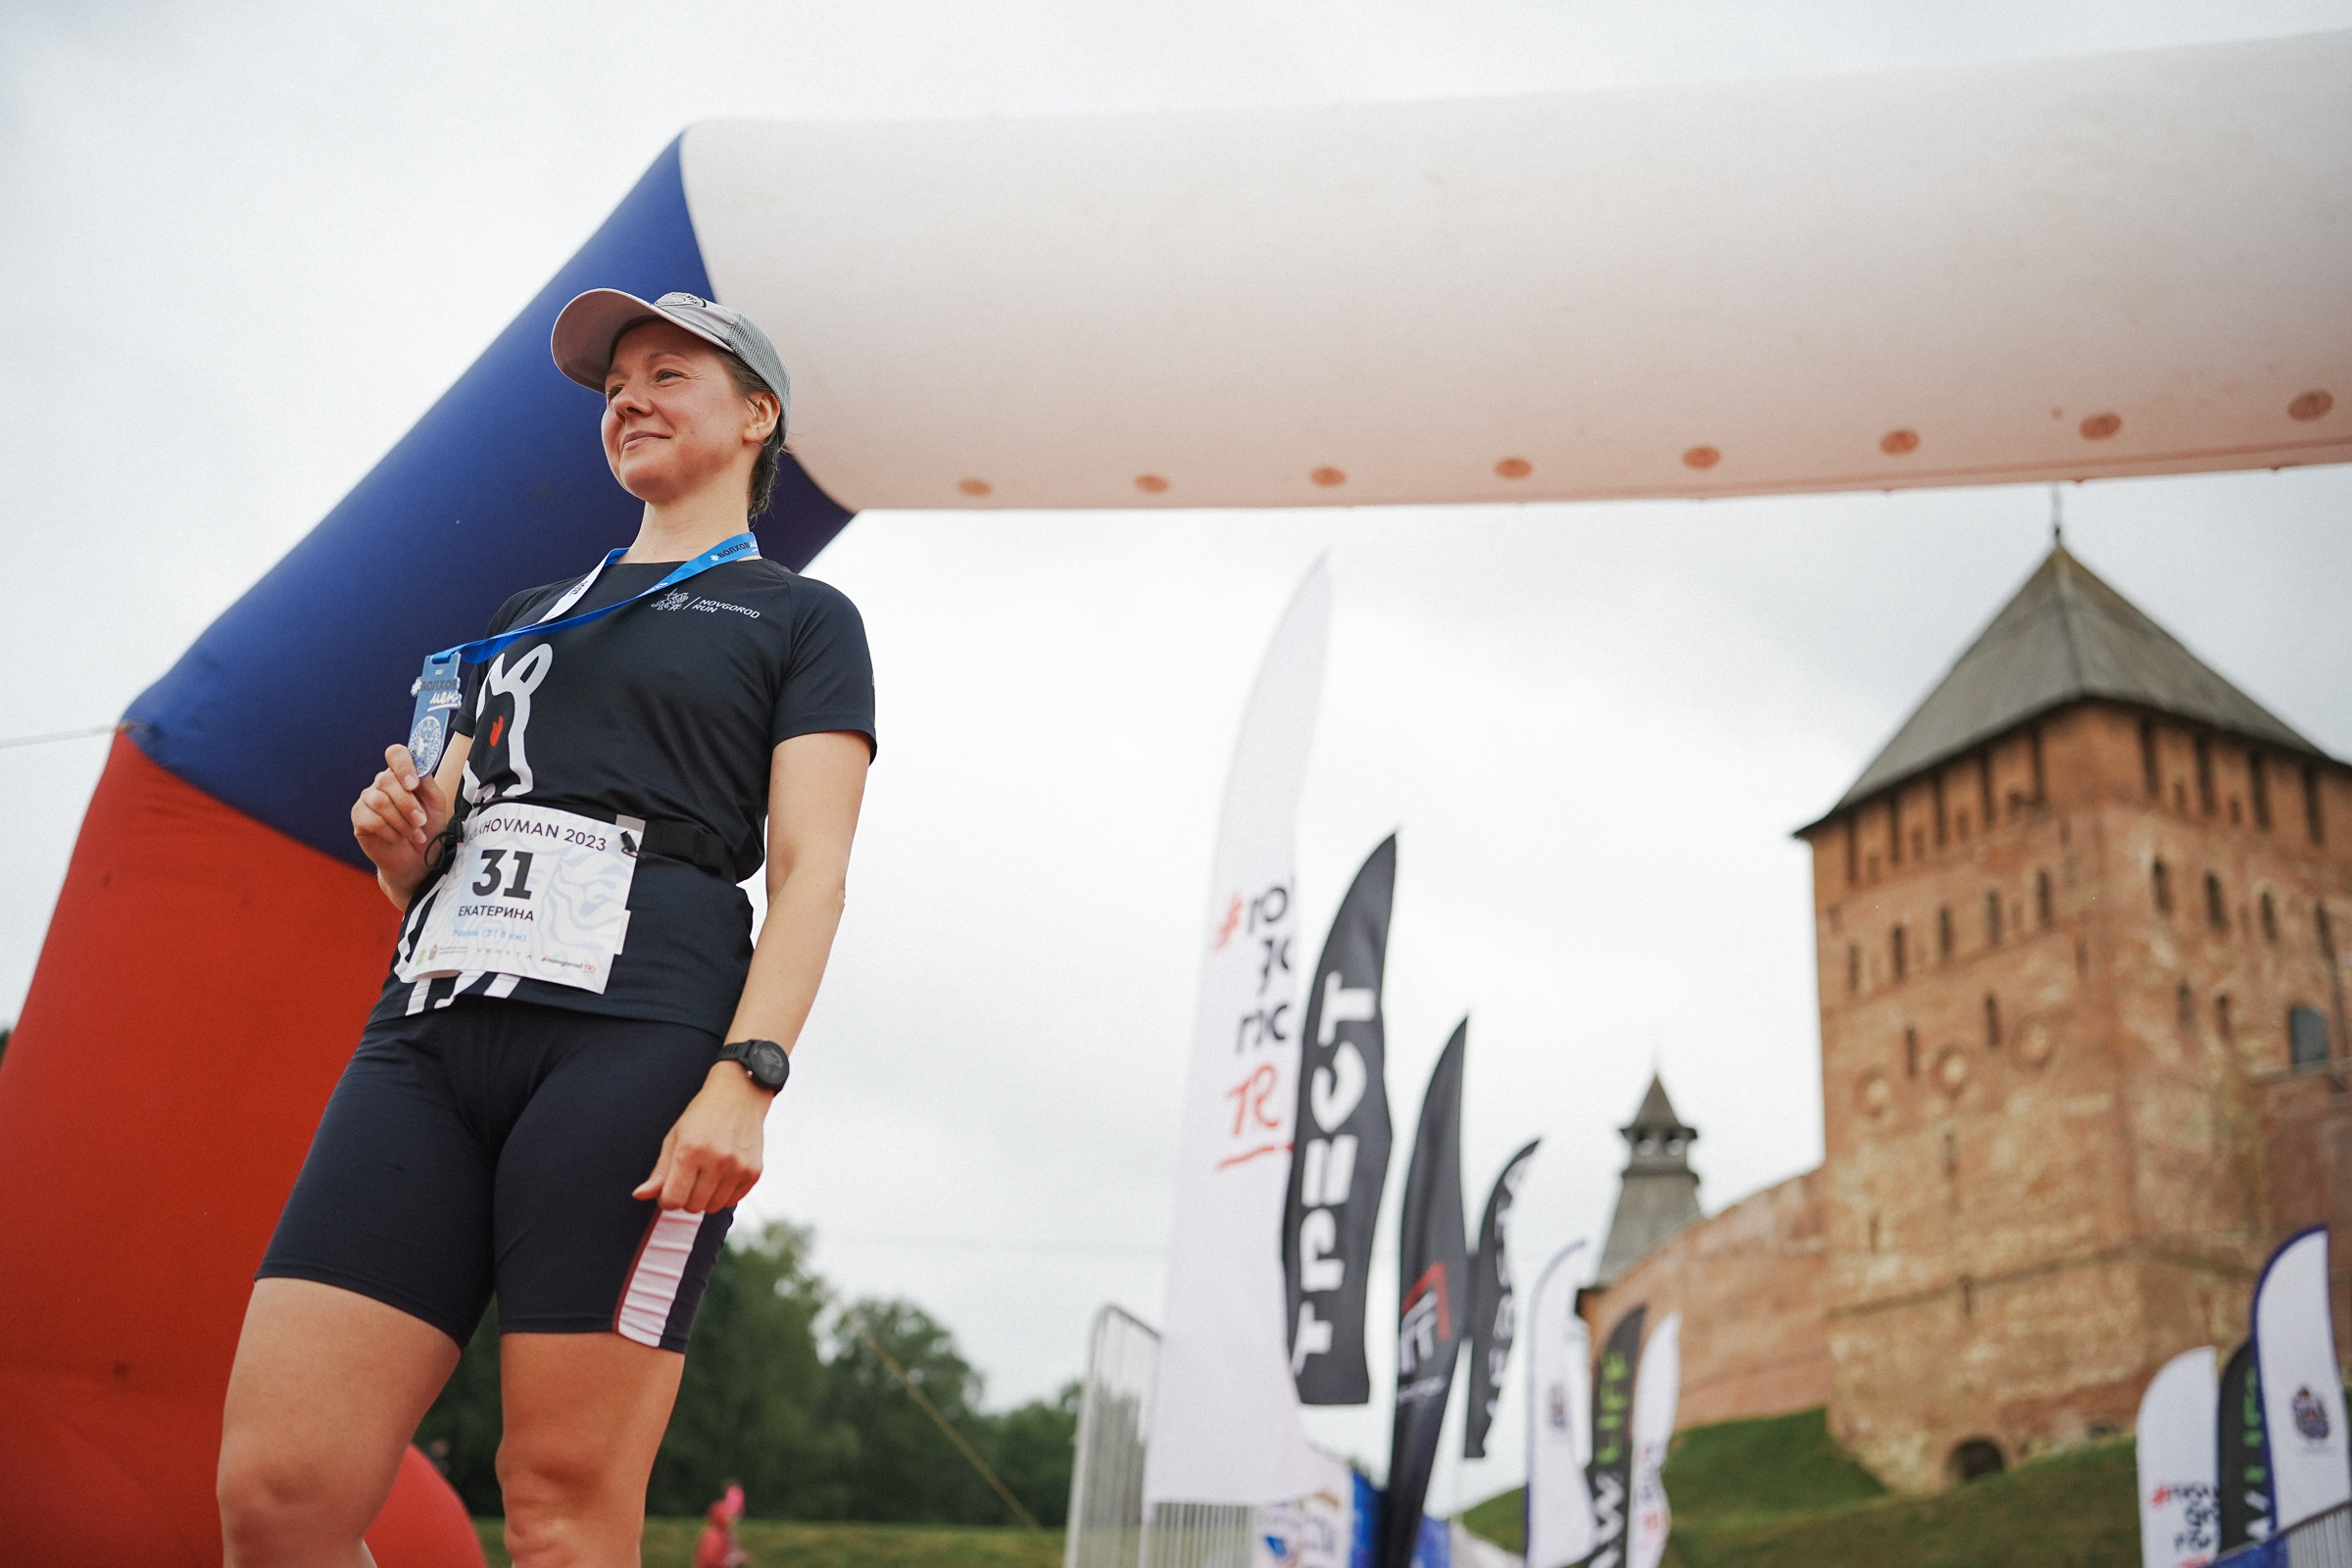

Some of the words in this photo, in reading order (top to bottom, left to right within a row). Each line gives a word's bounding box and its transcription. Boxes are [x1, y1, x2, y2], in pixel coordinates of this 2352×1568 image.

[692, 604, 718, 613] RUN
[699, 599, 760, 619] NOVGOROD
[564, 828, 607, 852] 2023
[472, 849, 534, 900] 31
[458, 906, 534, 921] ЕКАТЕРИНА
